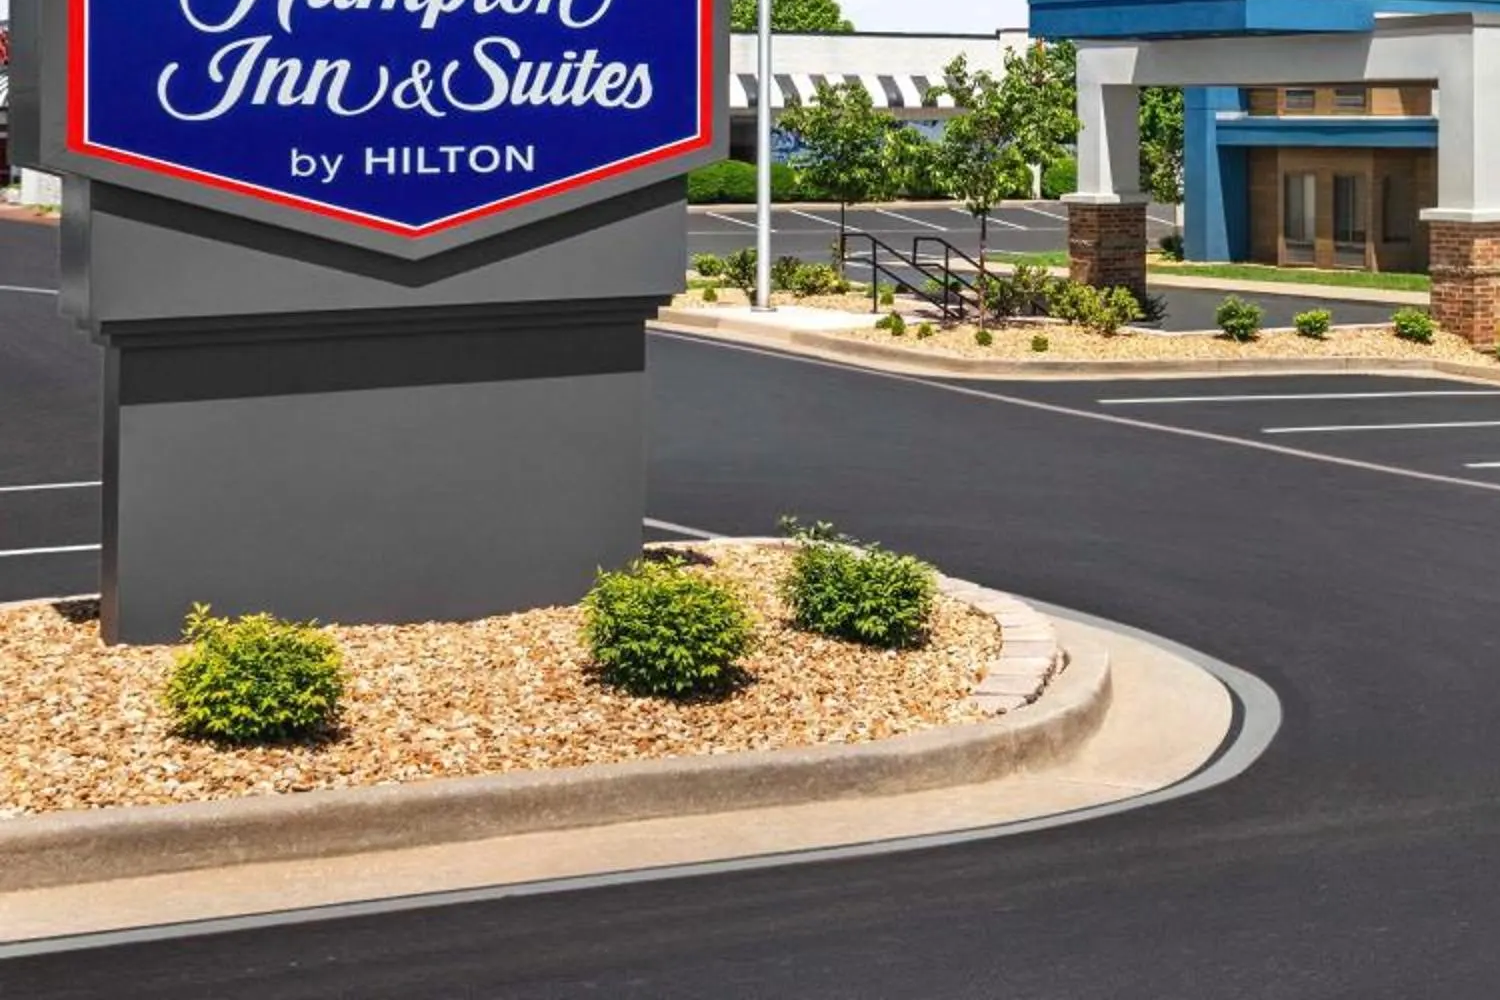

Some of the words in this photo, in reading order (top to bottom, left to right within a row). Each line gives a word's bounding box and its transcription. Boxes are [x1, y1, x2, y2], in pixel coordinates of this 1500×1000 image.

[157, 35, 390, 121] Inn
[392, 59, 446, 117] &
[442, 36, 653, 112] Suites
[290, 147, 344, 184] by
[364, 144, 536, 176] HILTON
